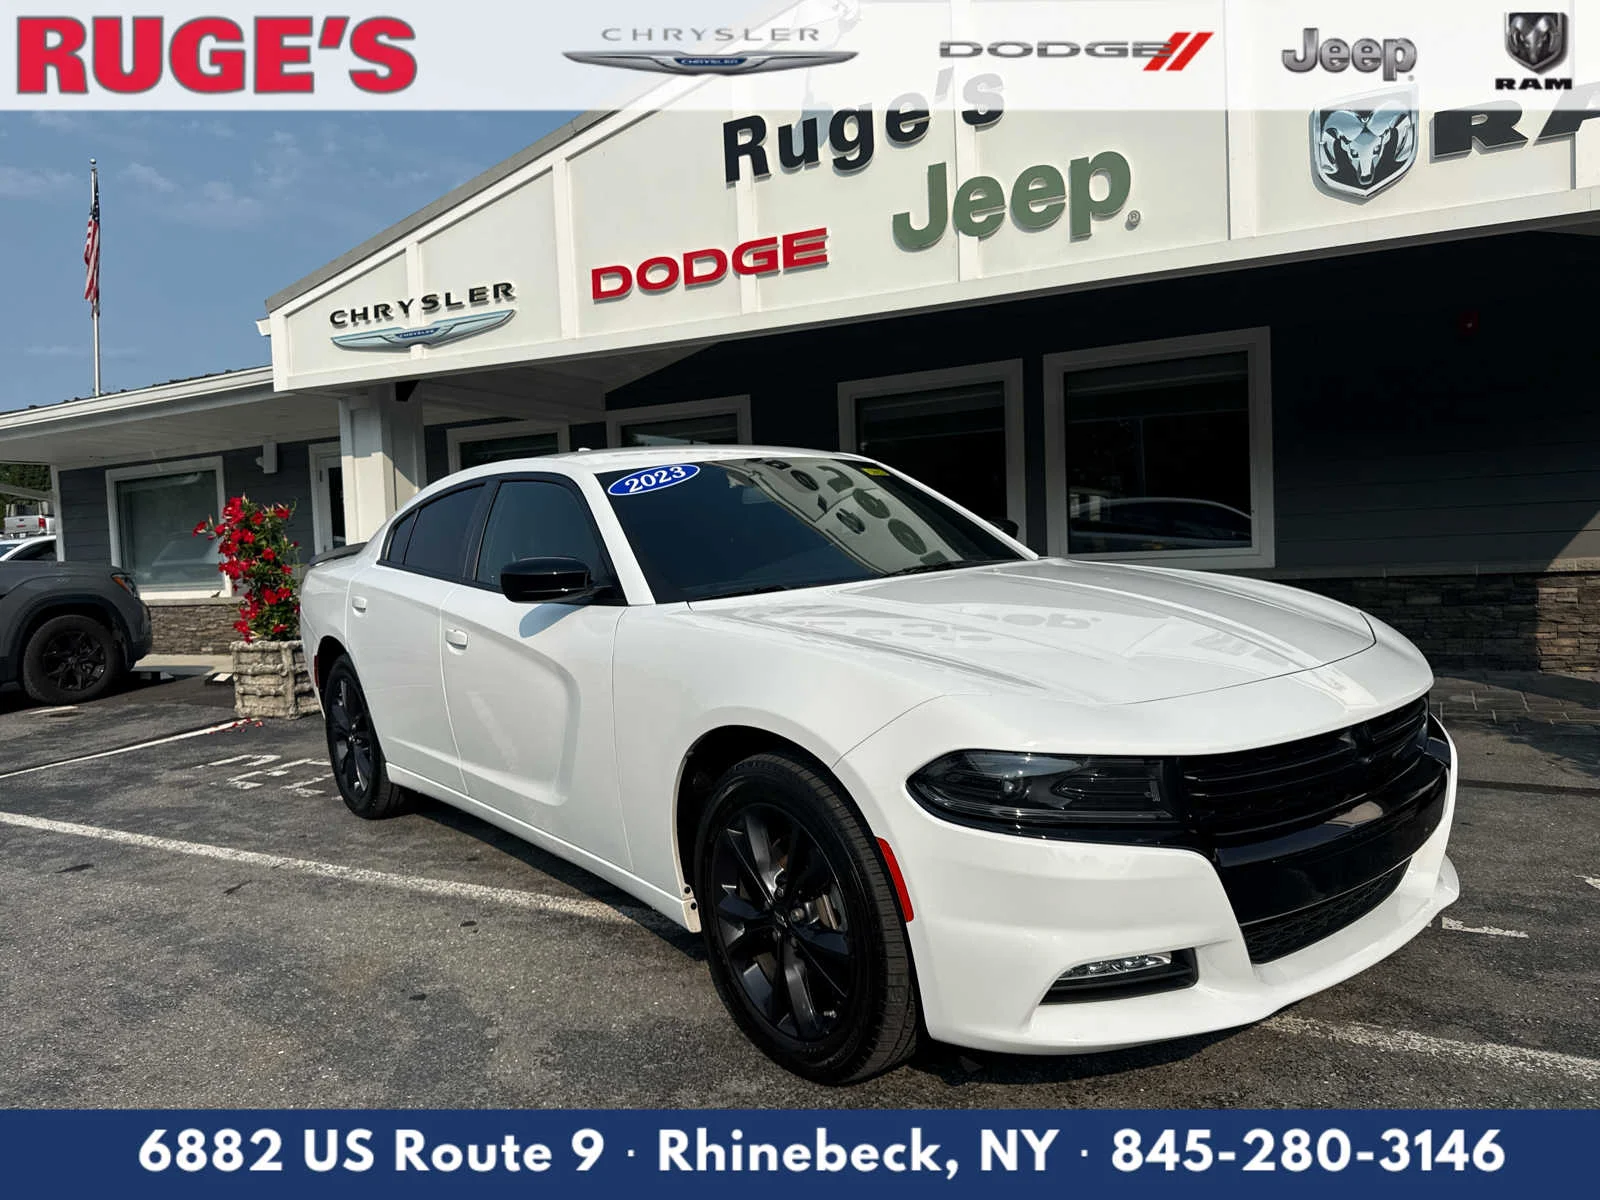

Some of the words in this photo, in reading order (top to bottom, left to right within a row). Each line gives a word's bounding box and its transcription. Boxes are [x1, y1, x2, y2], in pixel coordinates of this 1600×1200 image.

[723, 66, 1006, 184] Ruge's
[892, 149, 1132, 252] Jeep
[591, 227, 829, 302] DODGE
[329, 281, 513, 327] CHRYSLER
[624, 465, 687, 494] 2023
